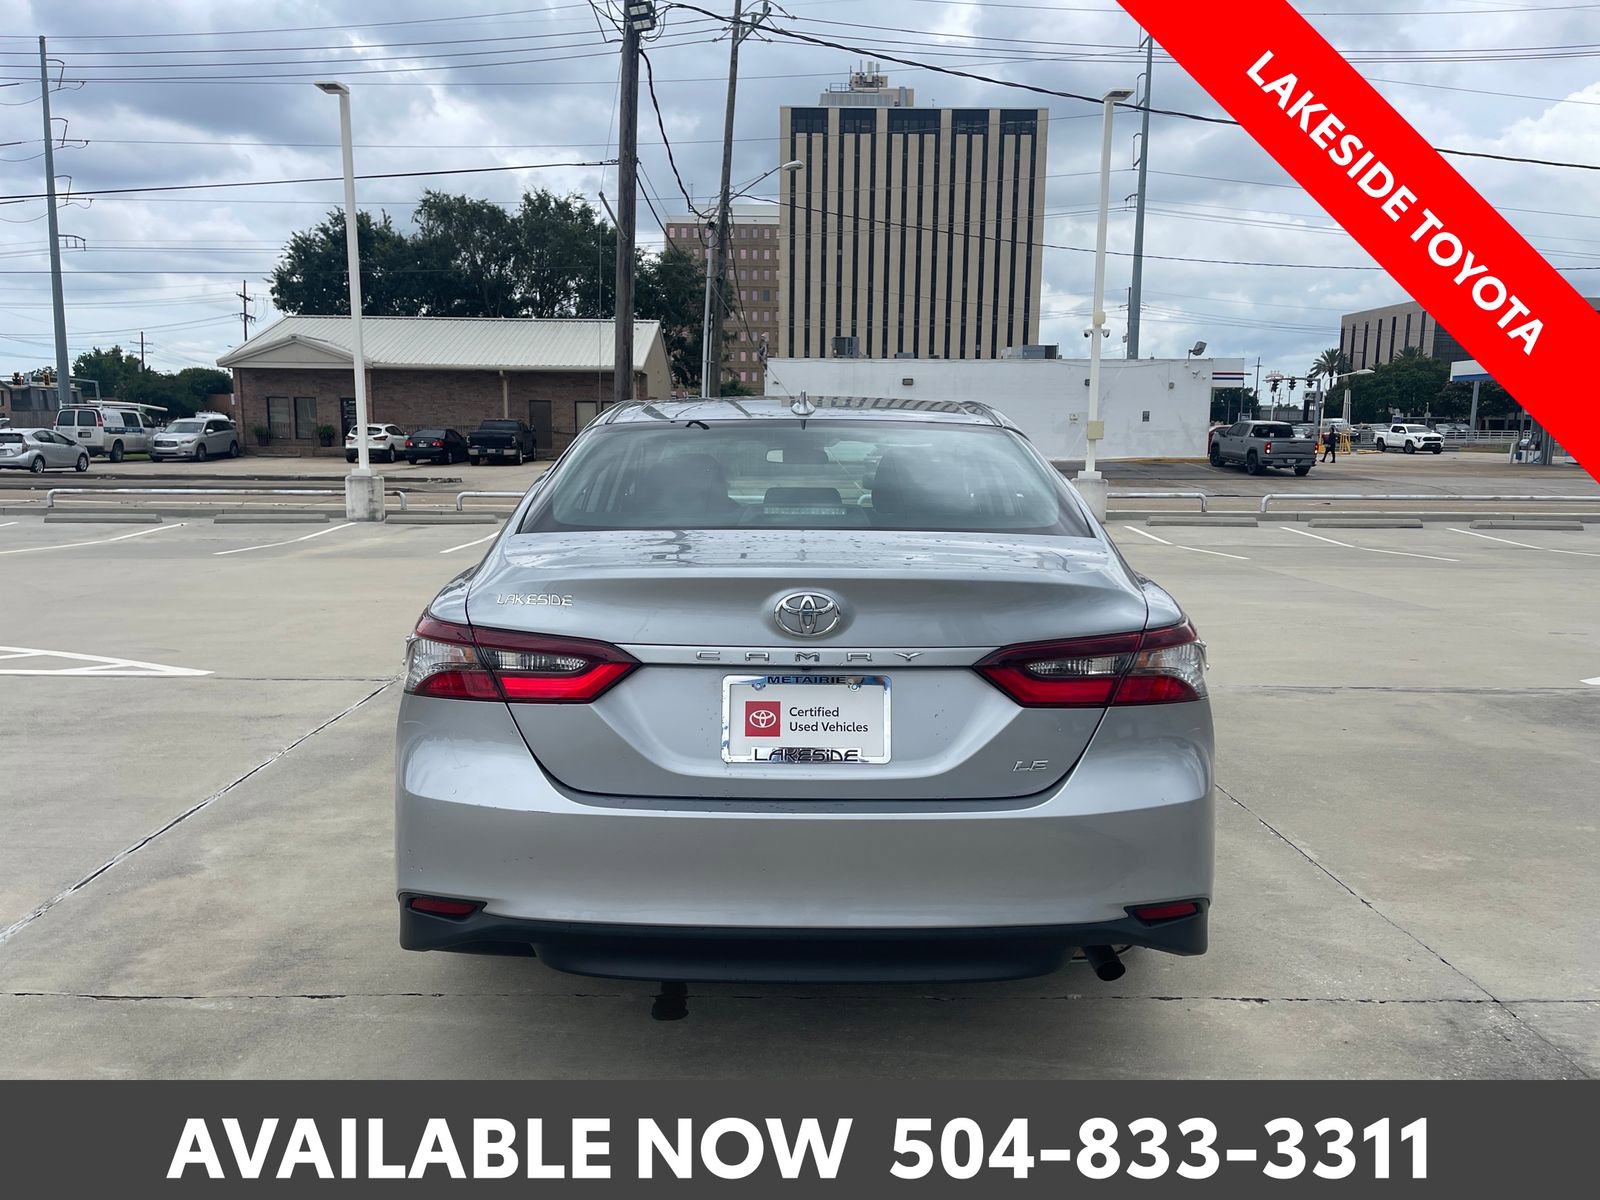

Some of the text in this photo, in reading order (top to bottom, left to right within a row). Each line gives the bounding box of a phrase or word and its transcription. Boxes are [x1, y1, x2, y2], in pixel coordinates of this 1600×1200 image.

[496, 593, 574, 607] LAKESIDE
[695, 650, 924, 662] CAMRY
[767, 675, 846, 685] METAIRIE
[789, 706, 840, 718] Certified
[789, 721, 869, 733] Used Vehicles
[1012, 760, 1049, 772] LE
